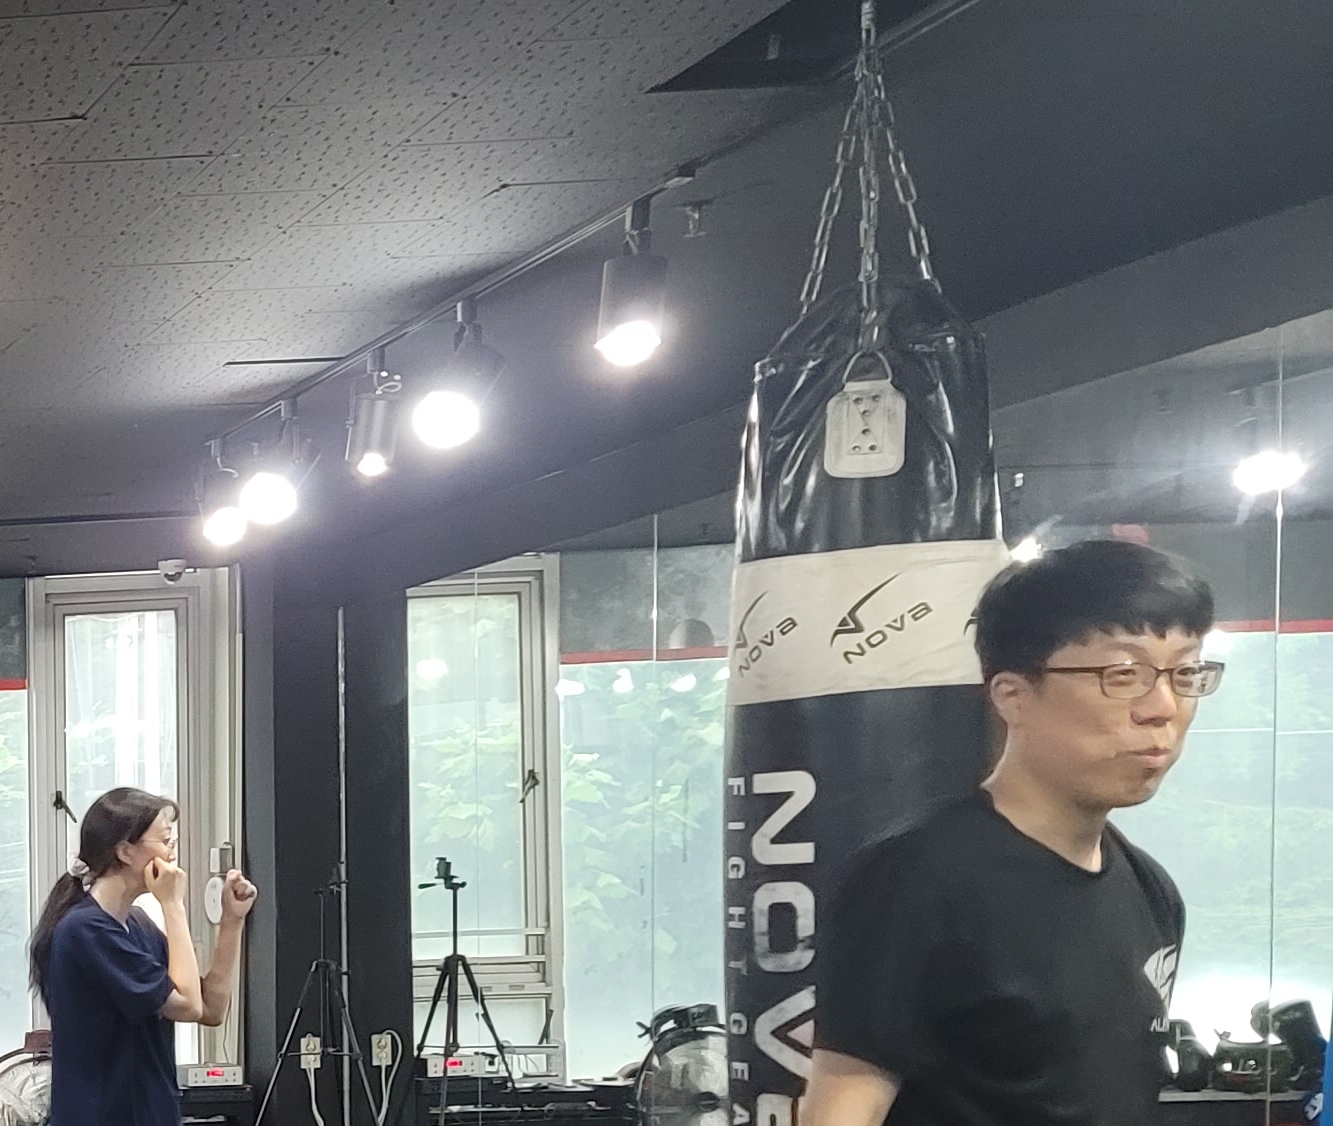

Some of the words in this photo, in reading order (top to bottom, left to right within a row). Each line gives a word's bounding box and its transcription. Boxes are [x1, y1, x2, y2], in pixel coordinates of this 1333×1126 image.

[738, 616, 798, 678] NOVA
[843, 601, 933, 664] NOVA
[727, 776, 748, 975] FIGHT
